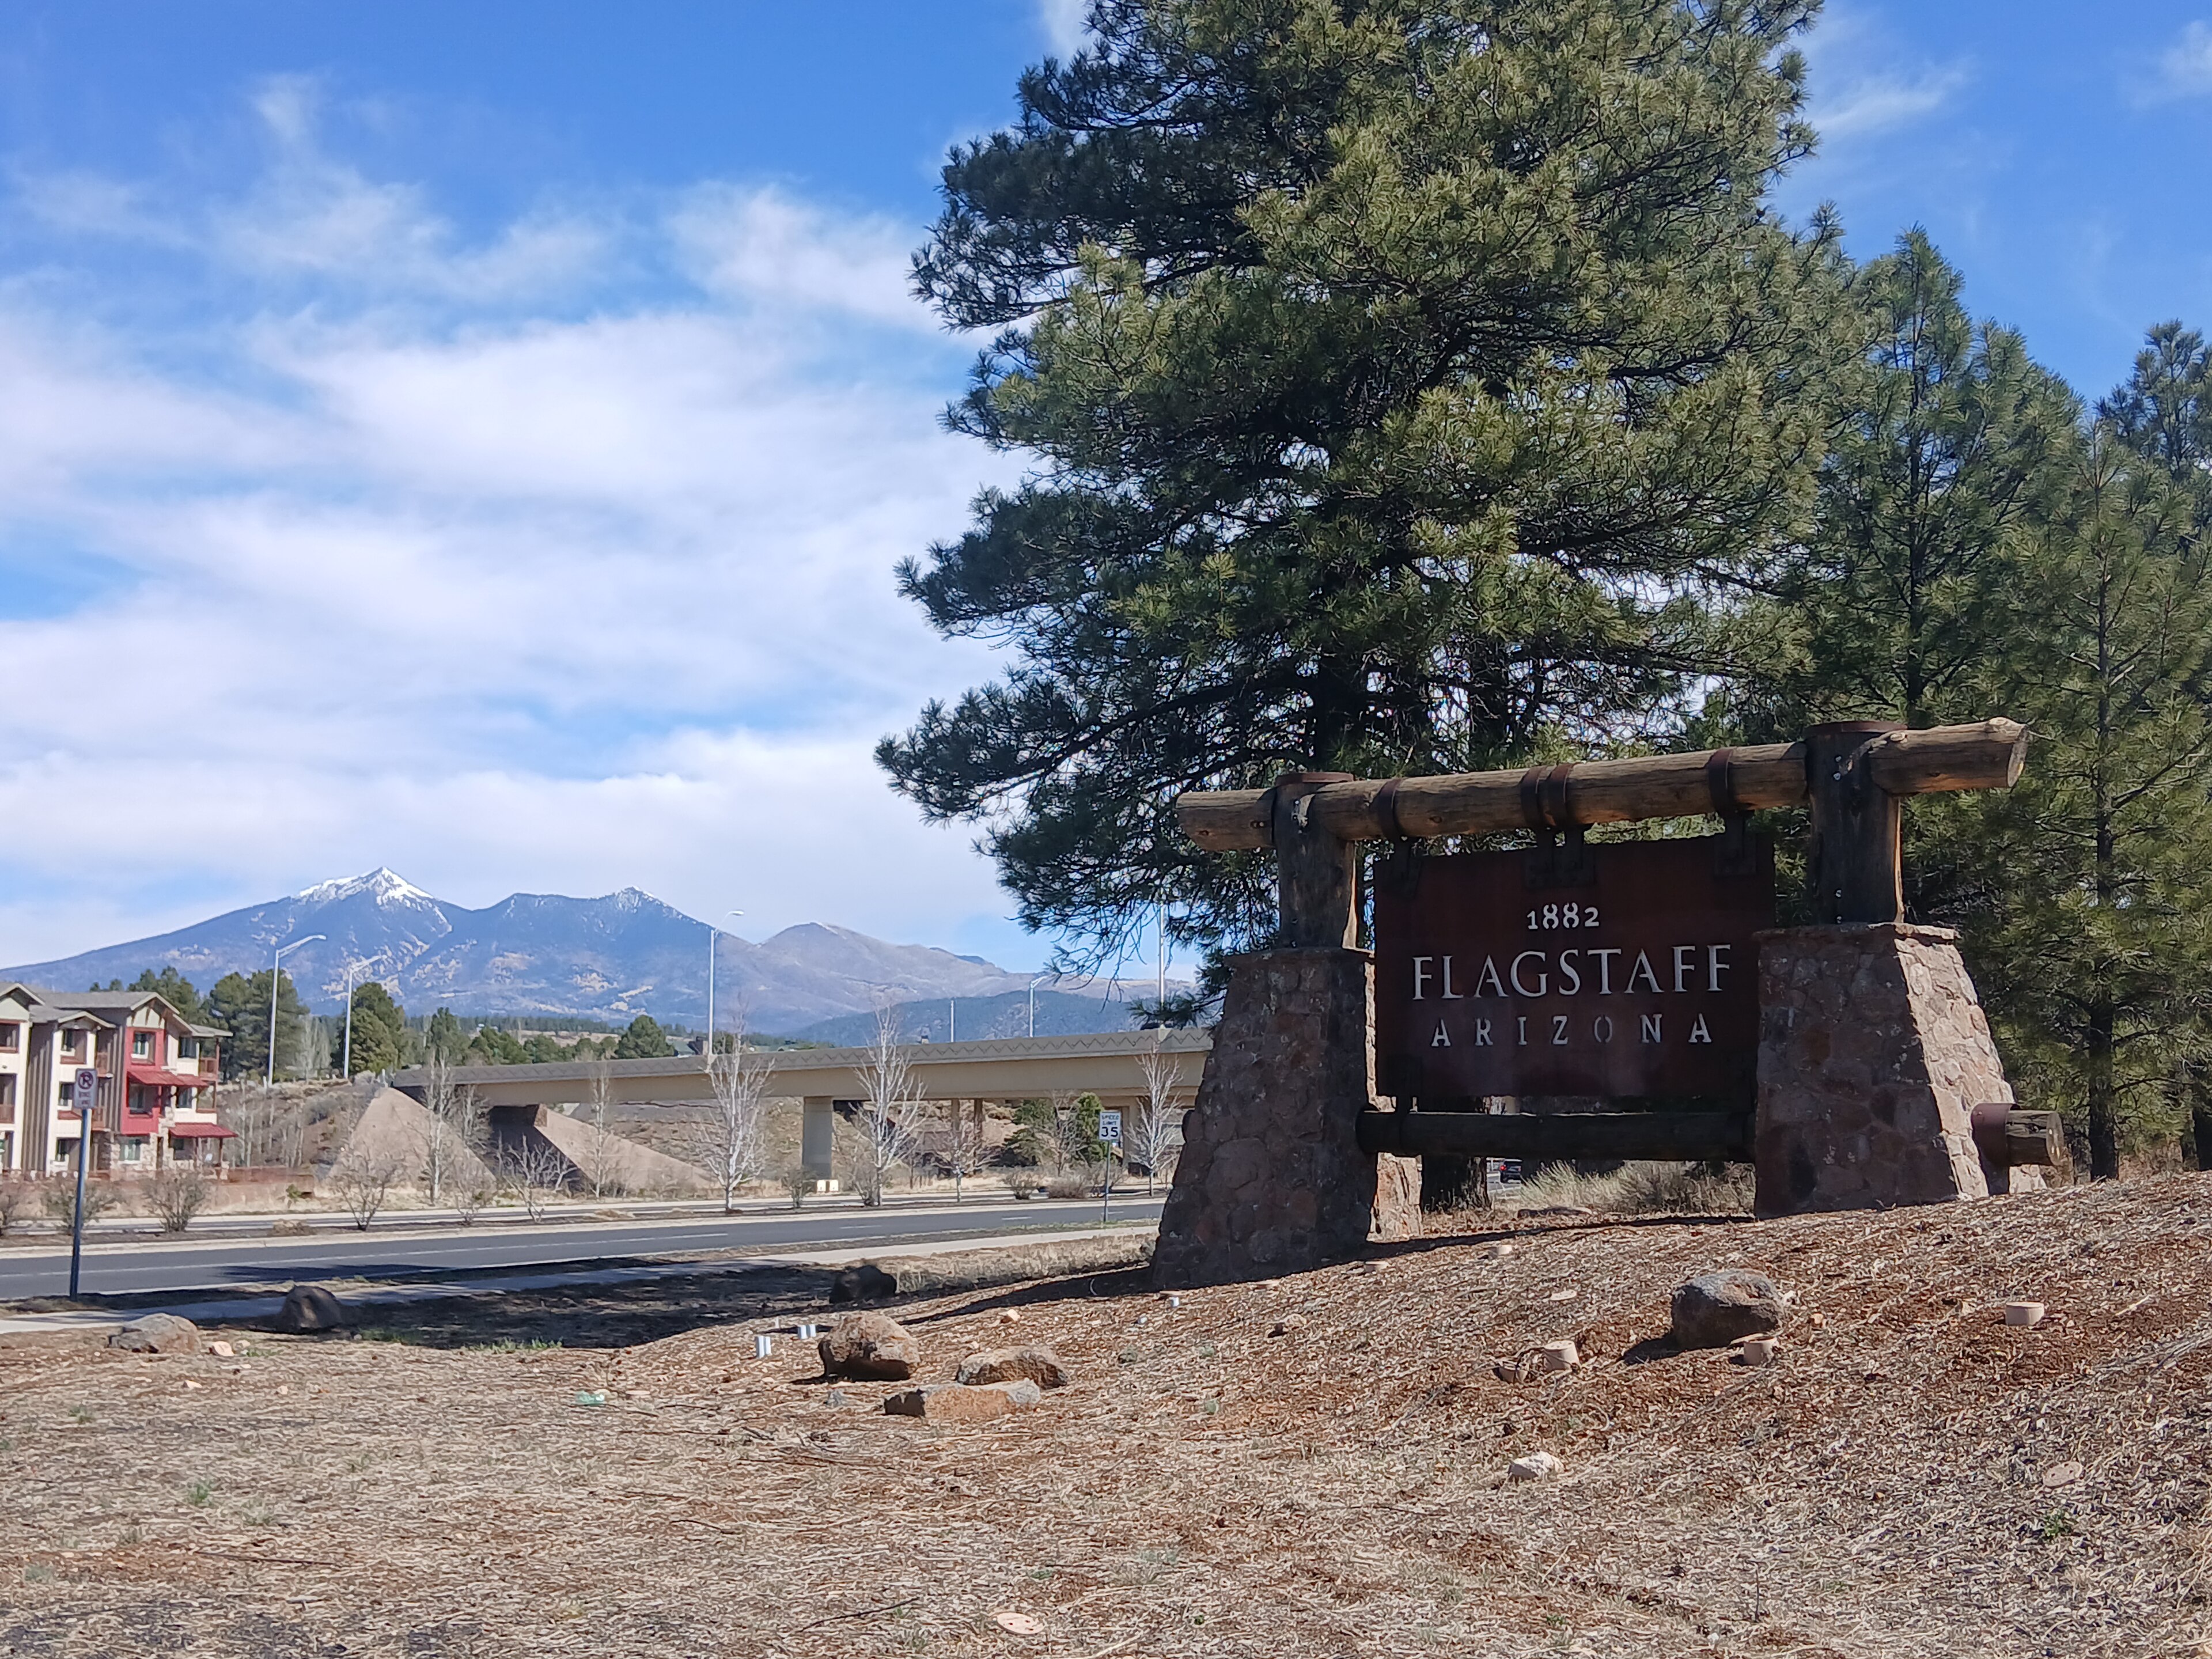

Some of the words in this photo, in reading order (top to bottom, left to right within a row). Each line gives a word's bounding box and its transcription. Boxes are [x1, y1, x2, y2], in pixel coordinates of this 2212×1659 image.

[1527, 902, 1600, 930] 1882
[1412, 944, 1731, 1000] FLAGSTAFF
[1431, 1013, 1712, 1047] ARIZONA
[1101, 1126, 1118, 1137] 35
